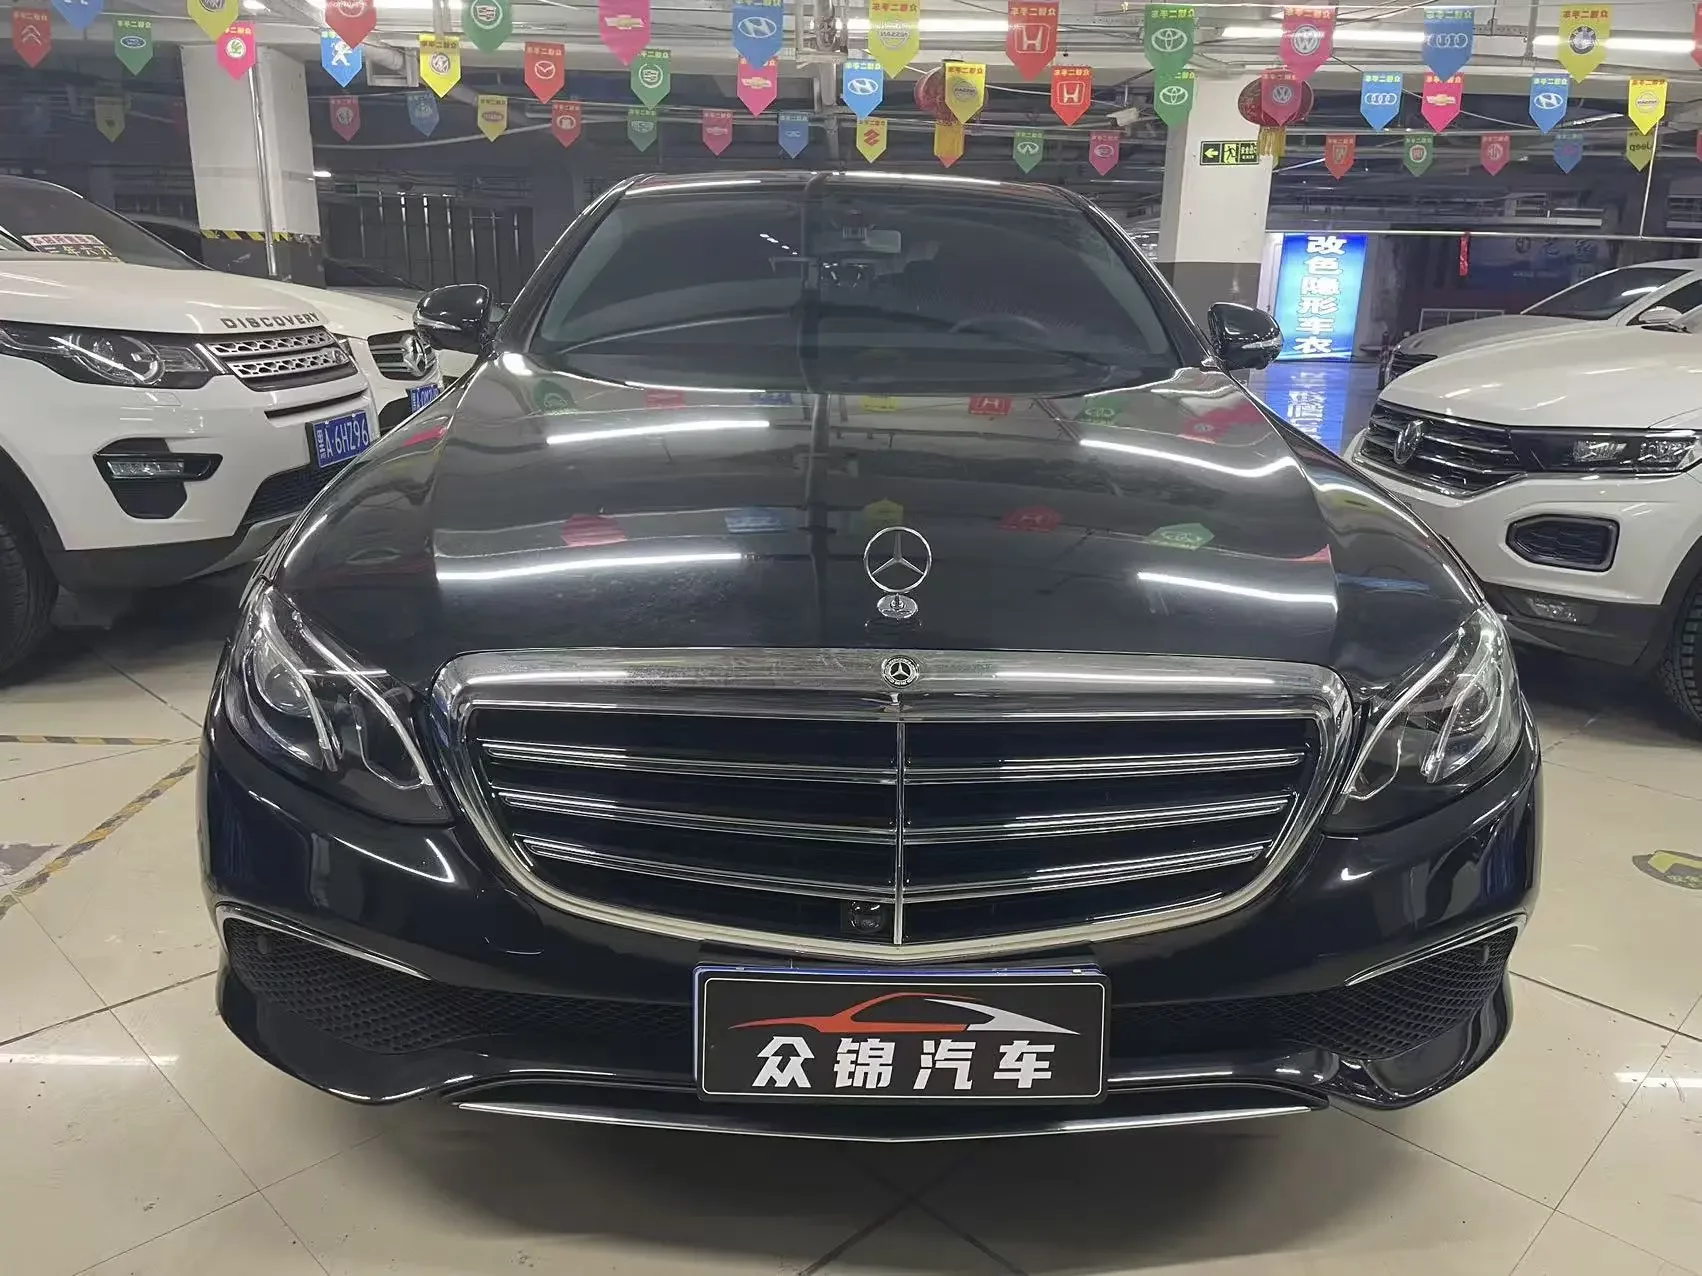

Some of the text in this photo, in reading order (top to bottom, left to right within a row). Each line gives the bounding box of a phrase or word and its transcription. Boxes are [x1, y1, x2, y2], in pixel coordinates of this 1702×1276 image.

[220, 312, 320, 328] DISCOVERY
[1293, 236, 1347, 354] 改色隐形车衣
[751, 1035, 1055, 1090] 众锦汽车
